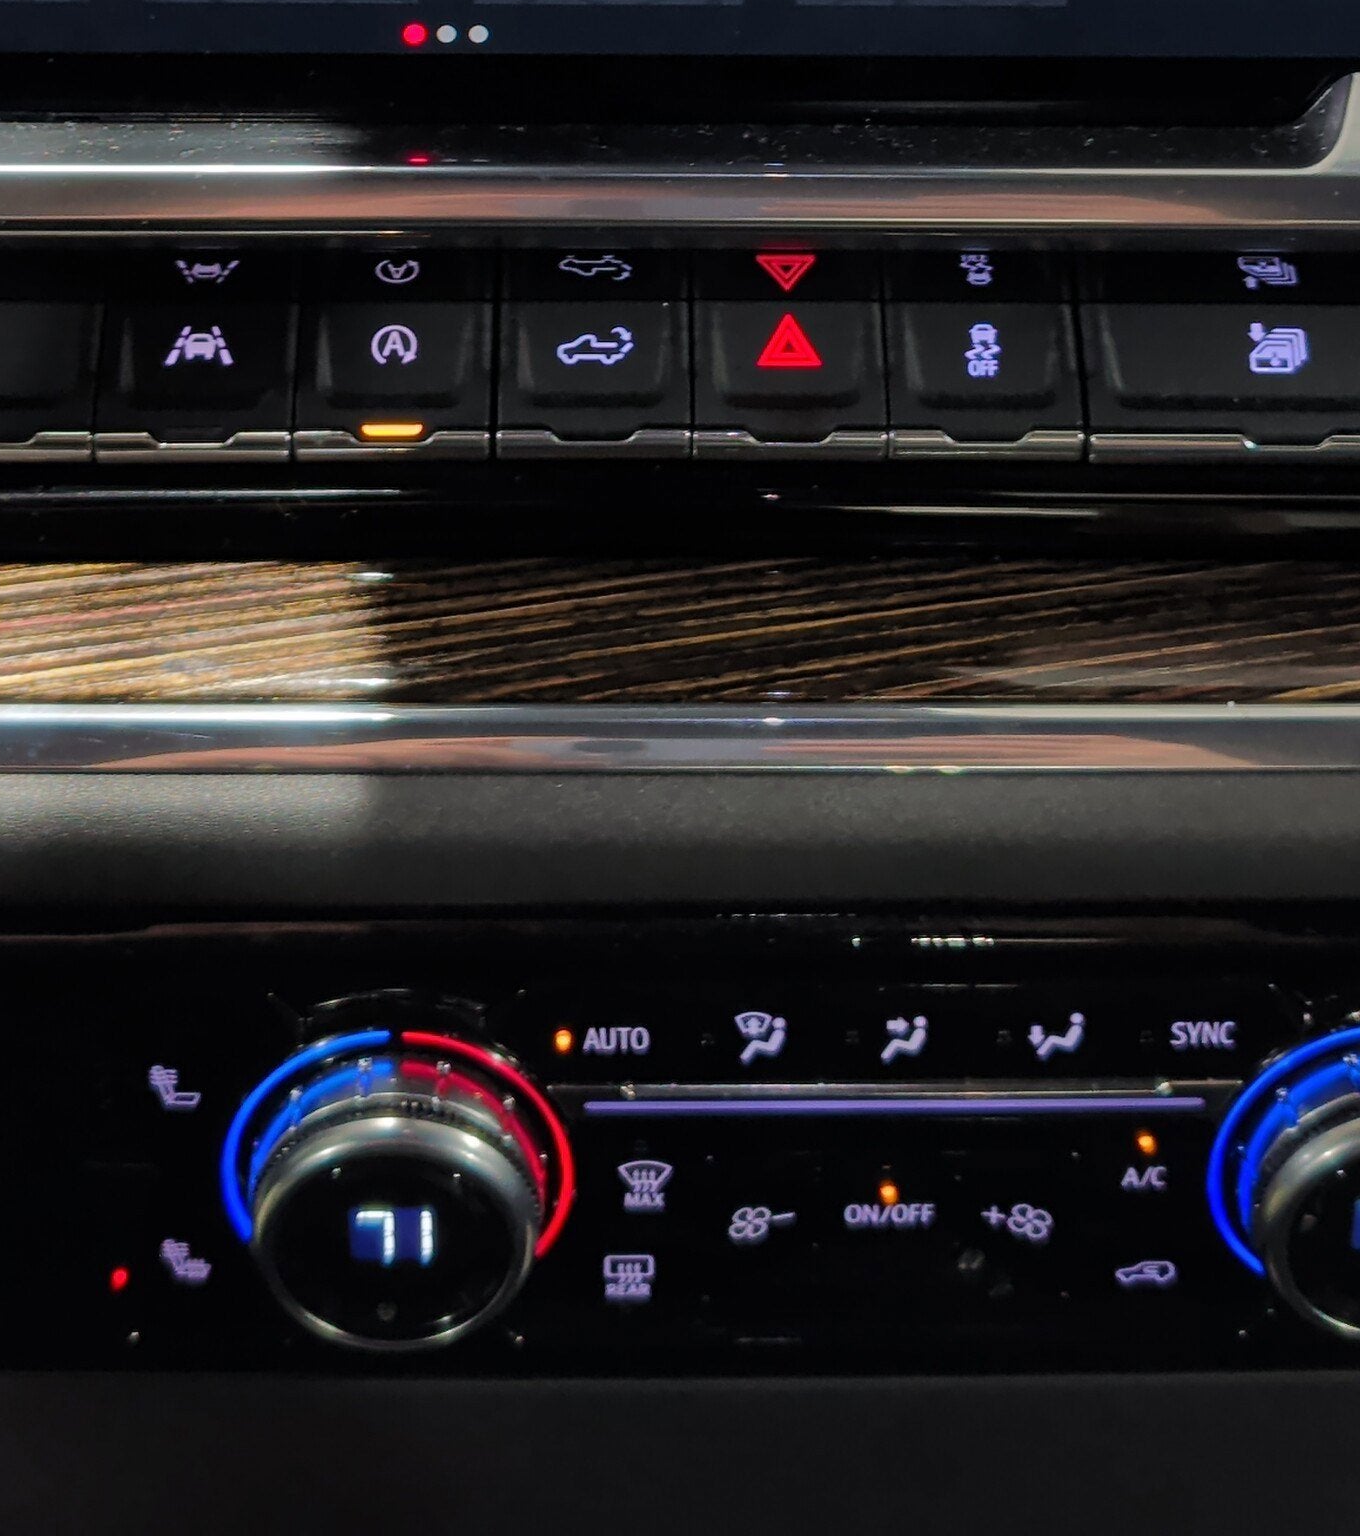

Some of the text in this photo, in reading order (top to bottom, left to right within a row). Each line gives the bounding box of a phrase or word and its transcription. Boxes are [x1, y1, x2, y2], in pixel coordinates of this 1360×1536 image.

[967, 359, 999, 376] OFF
[583, 1026, 650, 1055] AUTO
[1170, 1020, 1237, 1050] SYNC
[1121, 1165, 1167, 1190] A/C
[623, 1191, 665, 1210] MAX
[843, 1201, 935, 1226] ON/OFF
[355, 1209, 434, 1264] 71
